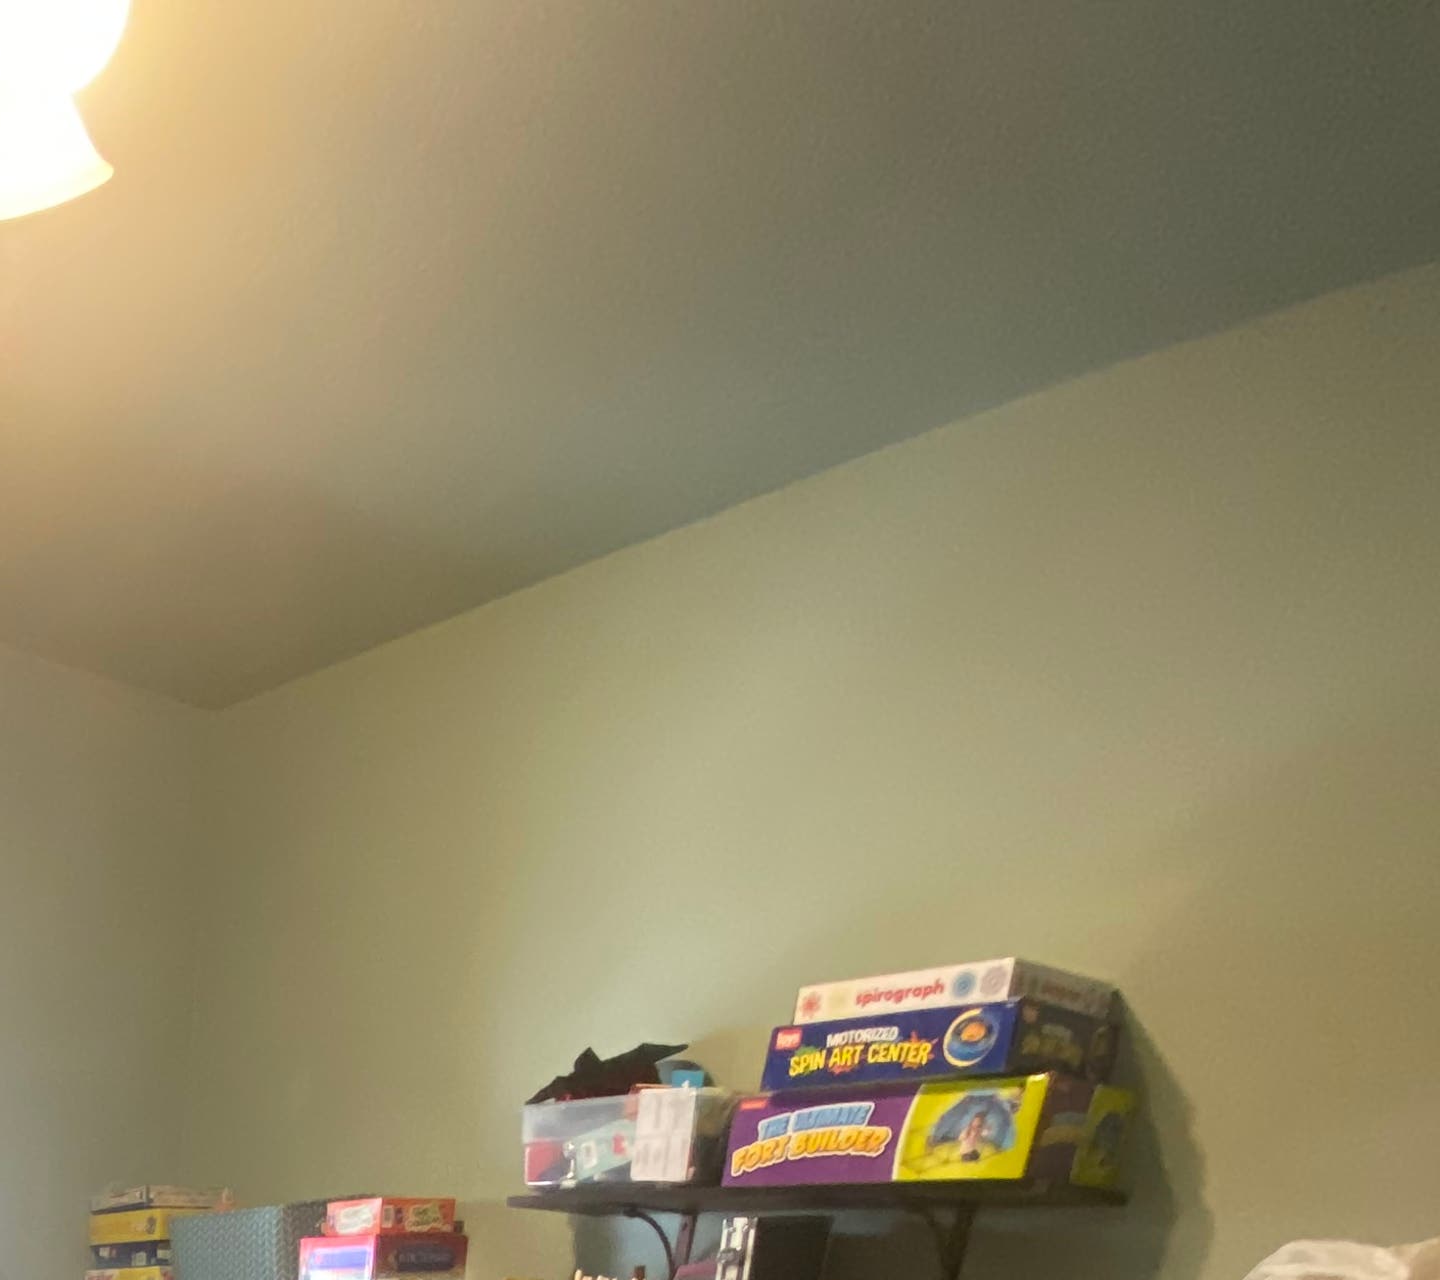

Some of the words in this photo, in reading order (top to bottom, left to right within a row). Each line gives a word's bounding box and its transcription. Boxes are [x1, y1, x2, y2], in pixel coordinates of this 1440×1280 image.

[856, 978, 945, 1007] spirograph
[826, 1026, 900, 1048] MOTORIZED
[789, 1050, 826, 1077] SPIN
[828, 1046, 861, 1067] ART
[867, 1042, 933, 1065] CENTER
[759, 1114, 791, 1141] THE
[793, 1103, 873, 1132] ULTIMATE
[732, 1136, 789, 1176] FORT
[790, 1127, 892, 1158] BUILDER
